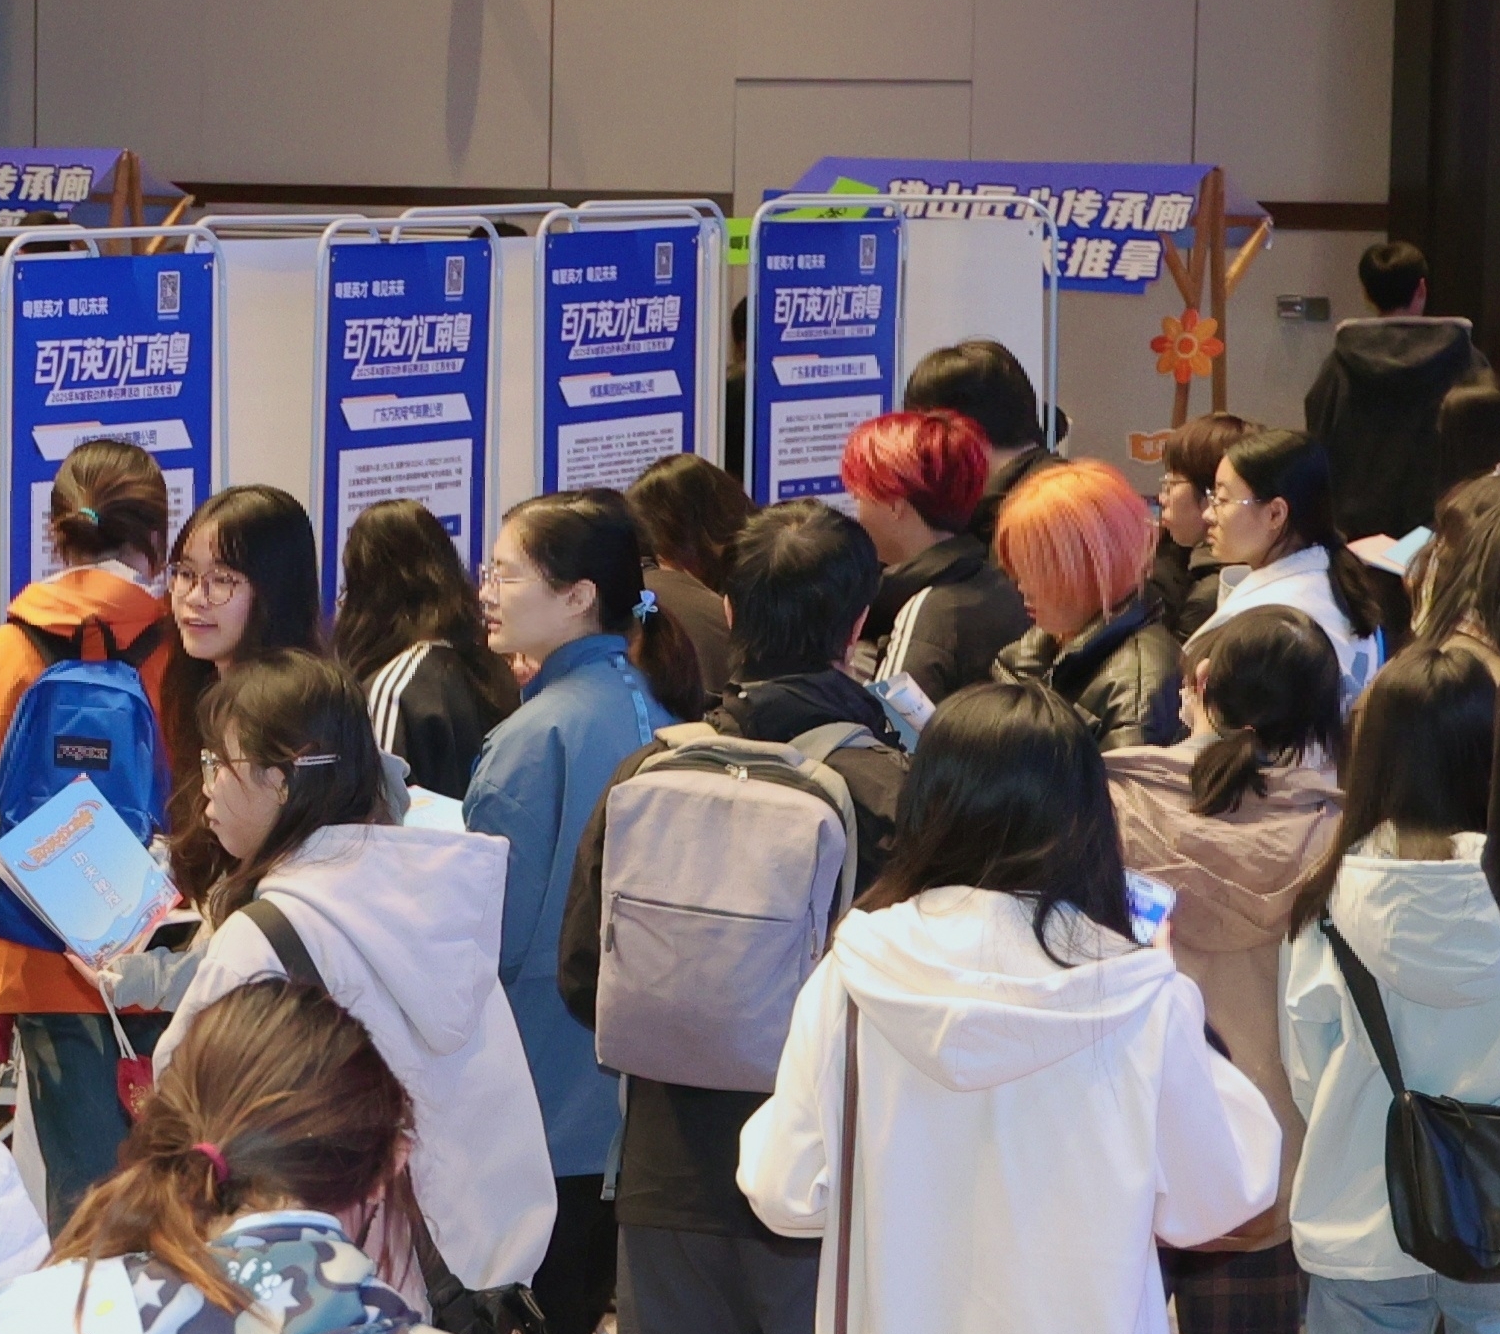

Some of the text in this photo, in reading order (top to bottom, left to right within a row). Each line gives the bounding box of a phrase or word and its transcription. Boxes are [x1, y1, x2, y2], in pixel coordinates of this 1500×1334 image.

[561, 294, 681, 347] 百万英才汇南粤
[774, 283, 882, 329] 百万英才汇南粤
[34, 331, 191, 391] 百万英才汇南粤
[343, 312, 472, 367] 百万英才汇南粤
